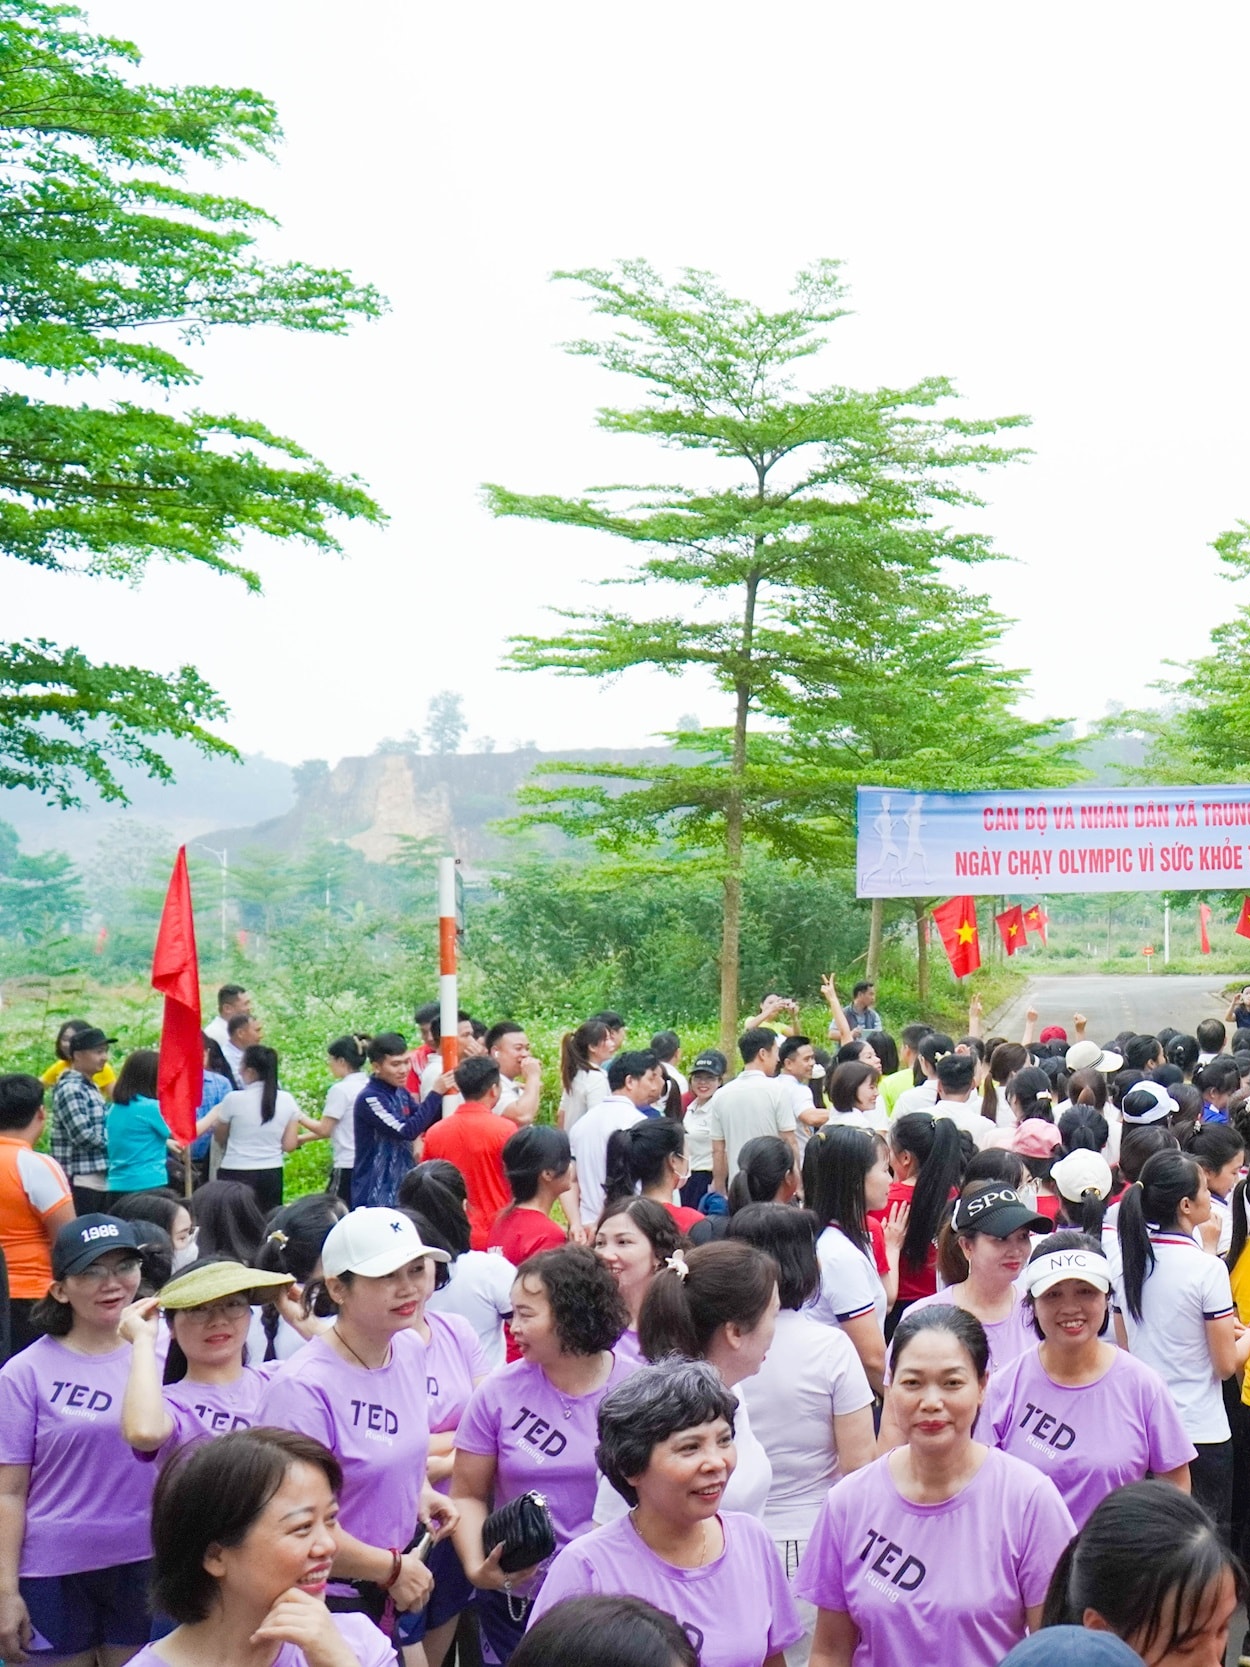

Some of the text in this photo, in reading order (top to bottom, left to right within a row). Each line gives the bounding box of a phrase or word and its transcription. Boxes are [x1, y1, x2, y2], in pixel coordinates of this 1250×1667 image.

[983, 802, 1019, 831] CÁN
[1025, 802, 1047, 835] BỘ
[1053, 801, 1075, 829] VÀ
[1081, 800, 1128, 829] NHÂN
[1134, 800, 1169, 828] DÂN
[1175, 799, 1197, 827] XÃ
[955, 845, 1001, 876] NGÀY
[1008, 849, 1053, 880] CHẠY
[1059, 847, 1133, 874] OLYMPIC
[1138, 841, 1154, 872] VÌ
[1160, 841, 1194, 872] SỨC
[1199, 837, 1243, 871] KHỎE
[967, 1189, 1022, 1217] SPO
[81, 1224, 119, 1243] 1986
[1050, 1254, 1086, 1270] NYC
[50, 1381, 113, 1412] TED
[351, 1399, 399, 1435] TED
[511, 1406, 567, 1457] TED
[1019, 1402, 1076, 1451] TED
[1025, 1434, 1057, 1460] Runing
[859, 1528, 926, 1591] TED
[864, 1570, 900, 1603] Runing
